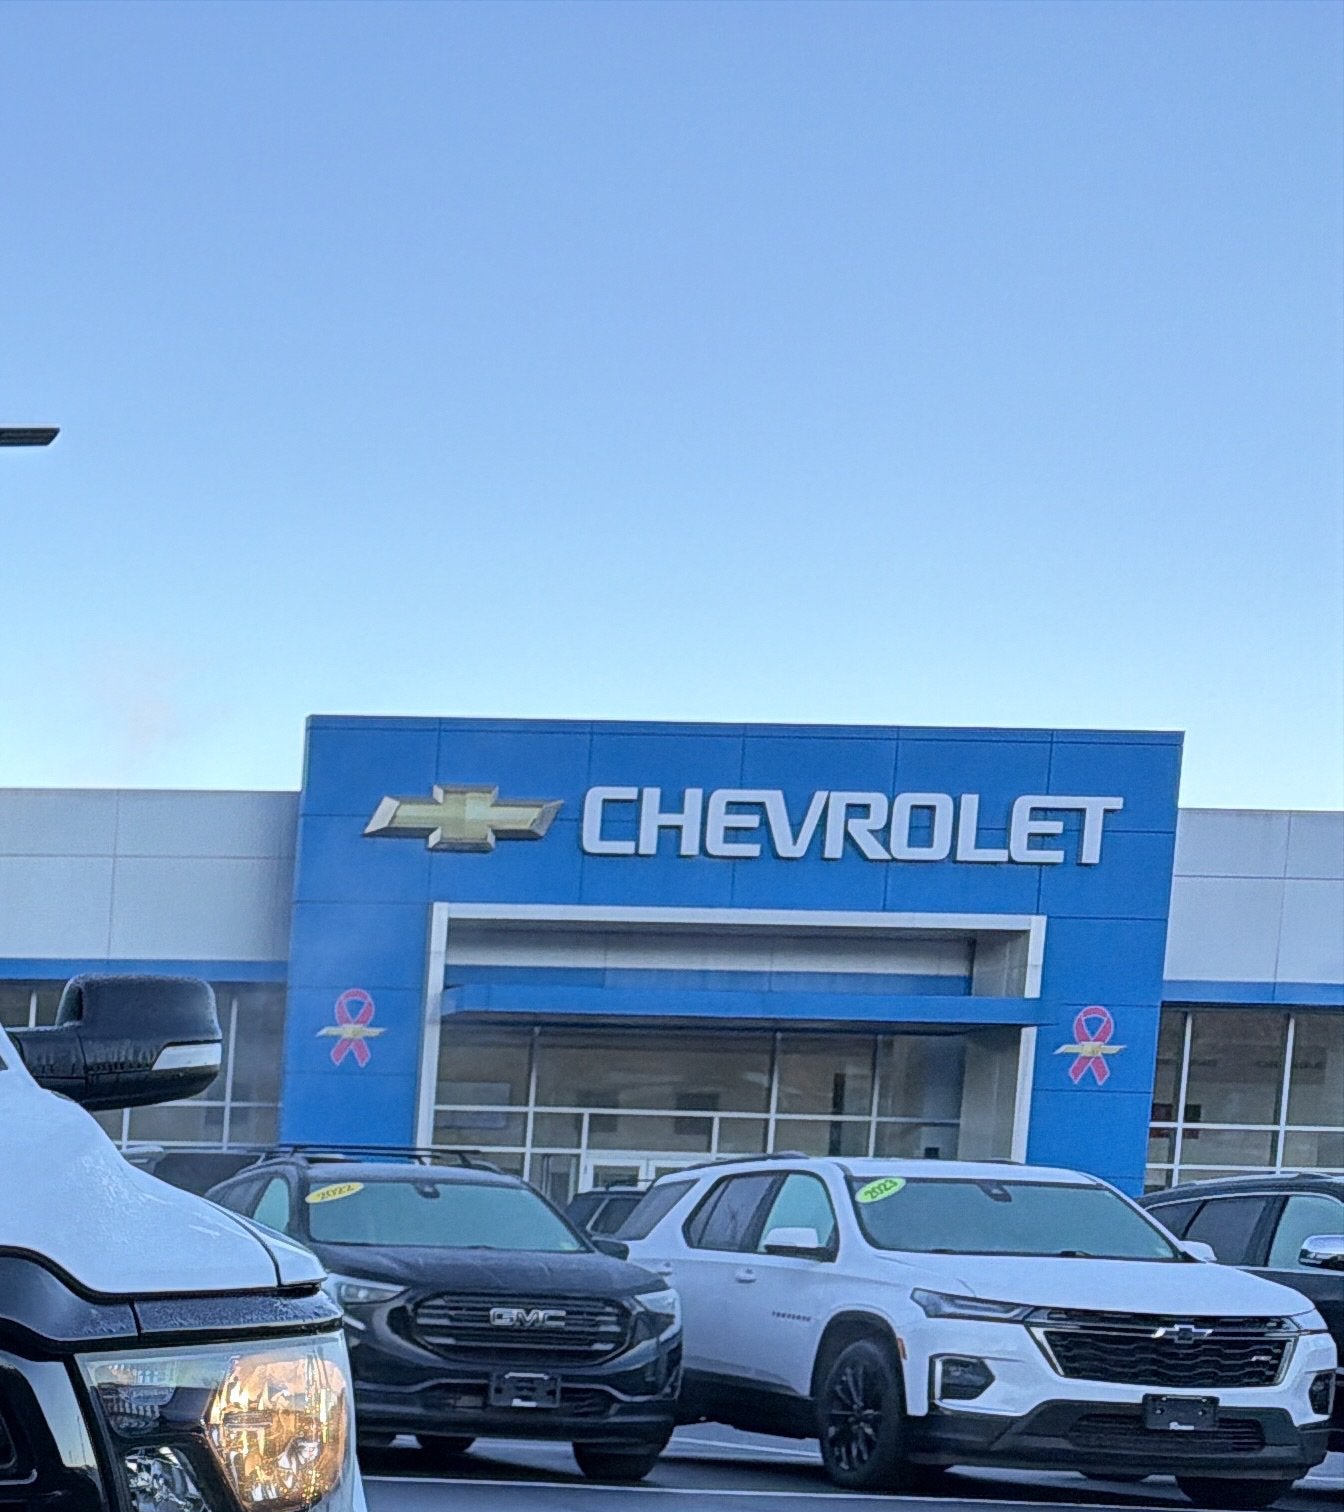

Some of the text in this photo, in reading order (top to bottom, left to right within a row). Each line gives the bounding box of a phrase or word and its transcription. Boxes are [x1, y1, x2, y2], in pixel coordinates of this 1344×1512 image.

[582, 786, 1124, 865] CHEVROLET
[863, 1179, 899, 1199] 2023
[489, 1307, 566, 1327] GMC
